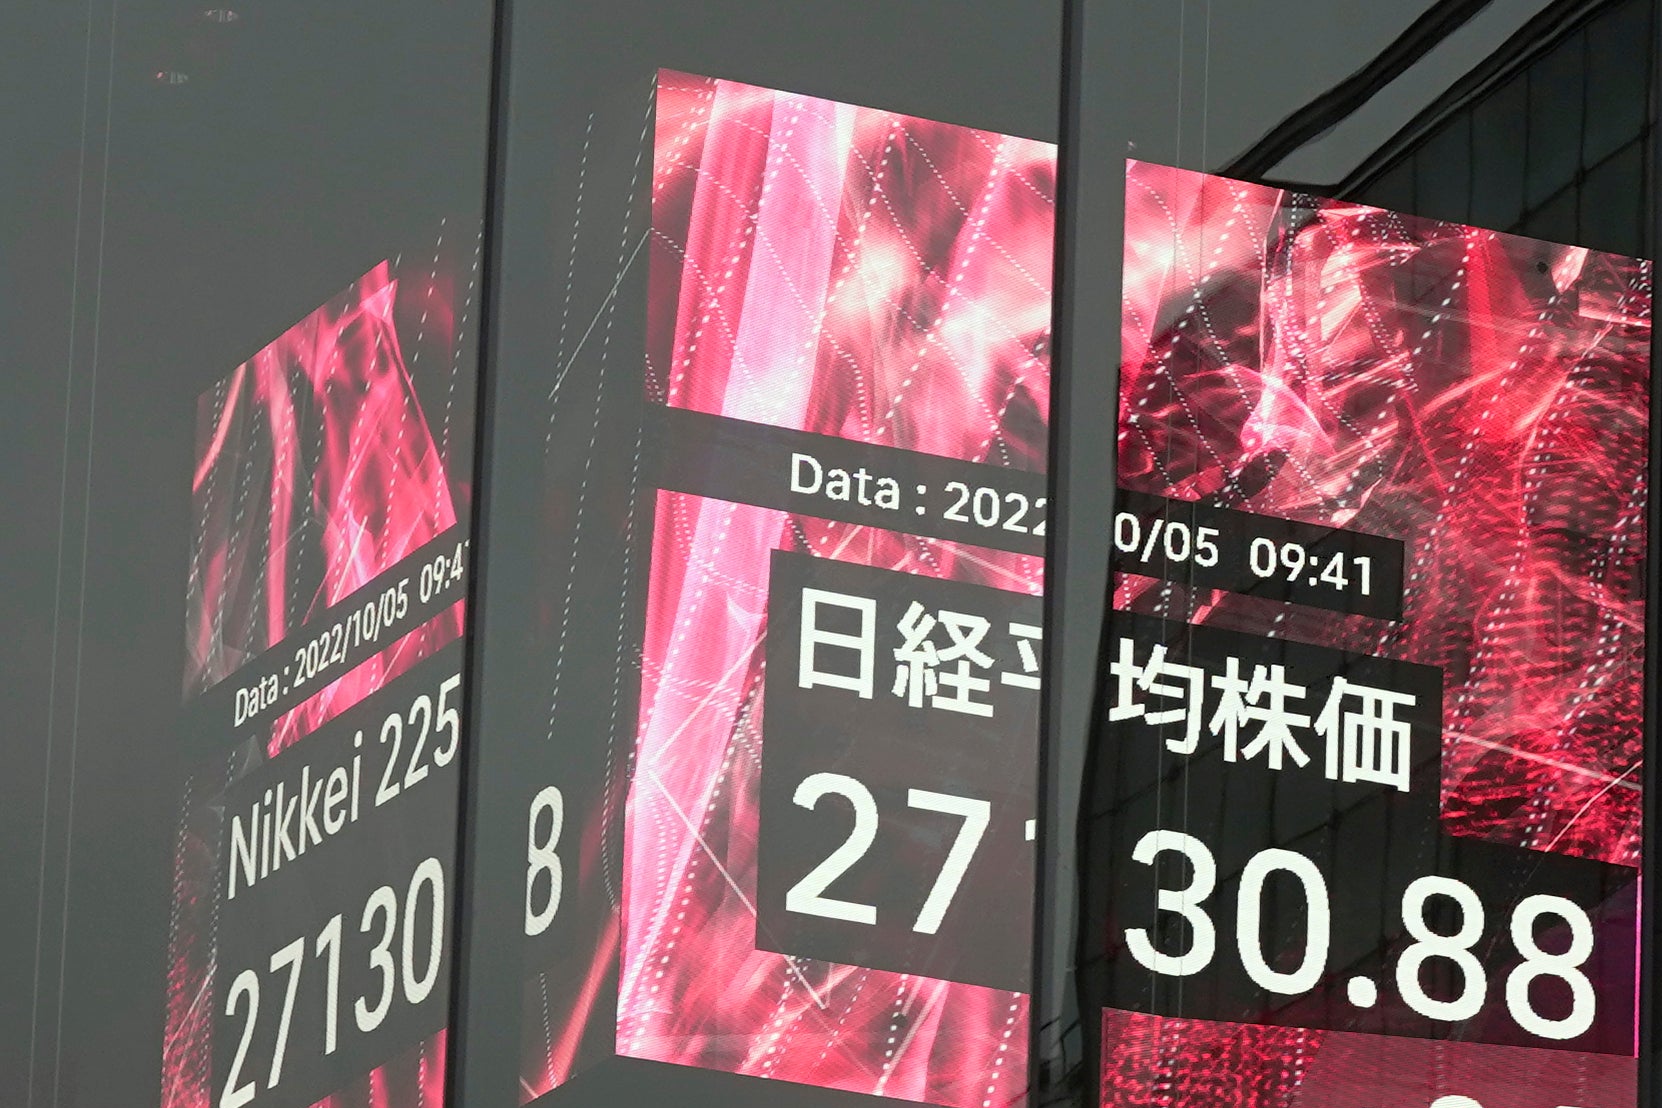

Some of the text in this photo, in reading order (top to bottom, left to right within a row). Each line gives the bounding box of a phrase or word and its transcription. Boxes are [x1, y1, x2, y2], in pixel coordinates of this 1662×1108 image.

[790, 452, 900, 510] Data
[1248, 537, 1374, 596] 09:41
[233, 670, 280, 727] Data
[293, 578, 409, 687] 2022/10/05
[419, 539, 470, 603] 09:4
[227, 673, 461, 900] Nikkei 225
